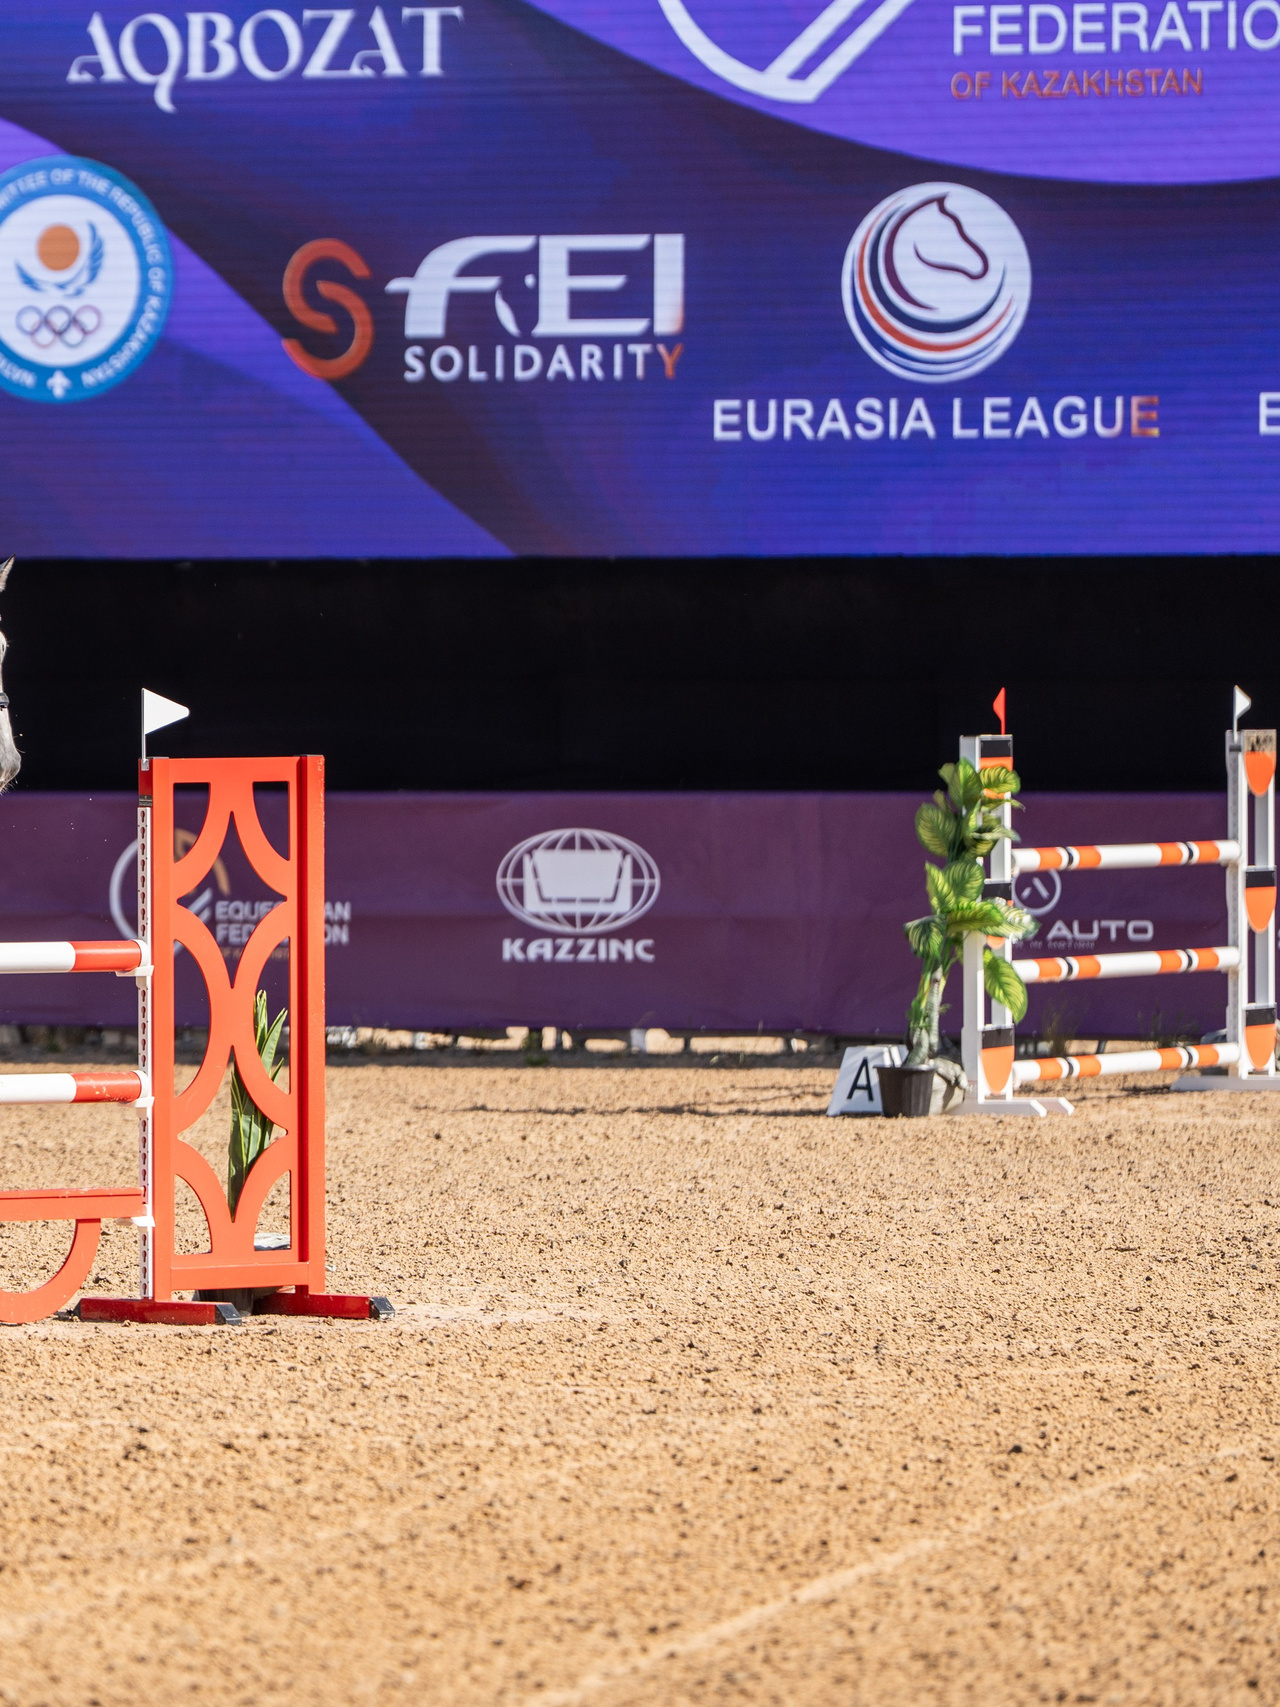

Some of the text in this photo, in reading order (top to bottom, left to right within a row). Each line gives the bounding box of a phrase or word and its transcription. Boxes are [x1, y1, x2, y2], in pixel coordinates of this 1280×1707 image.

[66, 6, 464, 113] AQBOZAT
[950, 67, 1202, 99] OF KAZAKHSTAN
[50, 167, 76, 186] OF
[78, 170, 111, 196] THE
[148, 266, 166, 294] OF
[385, 233, 685, 338] FEI
[403, 343, 684, 382] SOLIDARITY
[713, 395, 1160, 441] EURASIA LEAGUE
[502, 938, 656, 963] KAZZINC
[1046, 919, 1155, 942] AUTO
[846, 1056, 874, 1102] A
